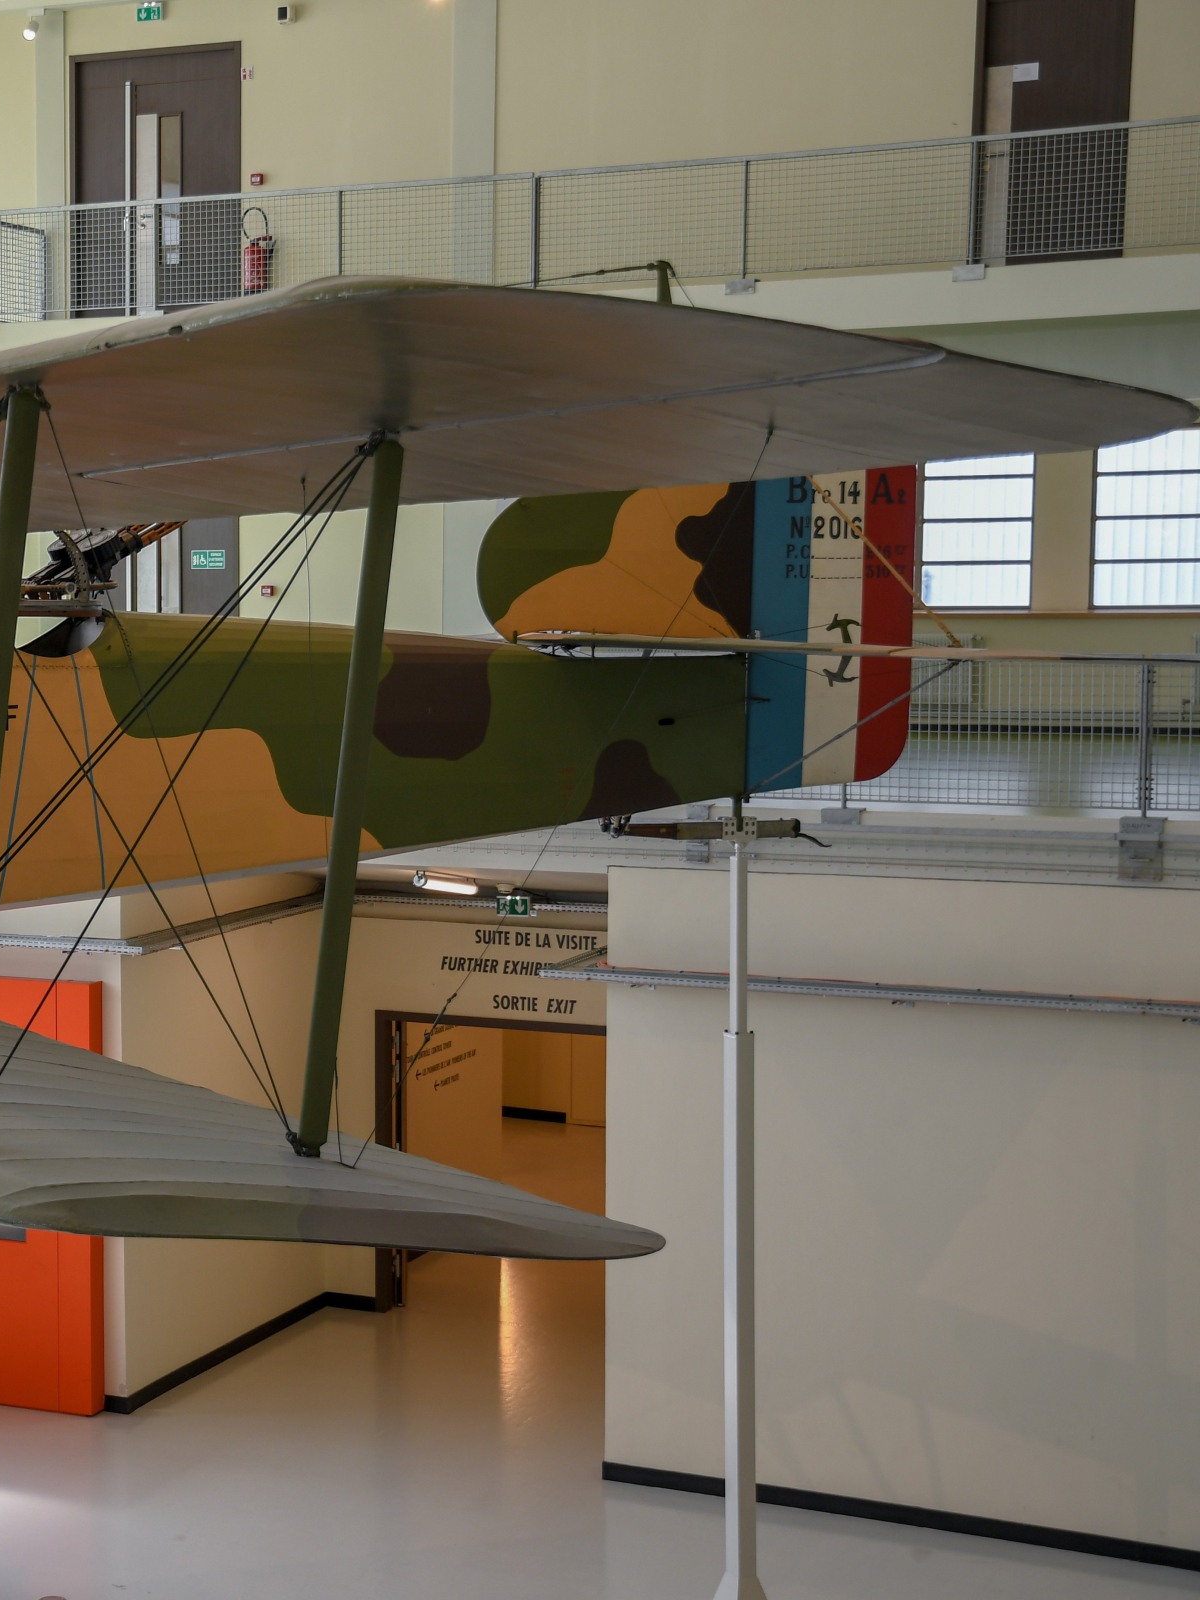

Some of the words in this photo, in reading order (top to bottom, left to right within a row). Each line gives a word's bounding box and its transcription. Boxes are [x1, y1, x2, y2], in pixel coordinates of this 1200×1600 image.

[838, 480, 861, 505] 14
[812, 515, 863, 540] 2016
[474, 928, 511, 947] SUITE
[515, 931, 531, 947] DE
[535, 932, 552, 948] LA
[556, 934, 598, 951] VISITE
[440, 955, 499, 974] FURTHER
[492, 994, 538, 1012] SORTIE
[546, 998, 577, 1014] EXIT
